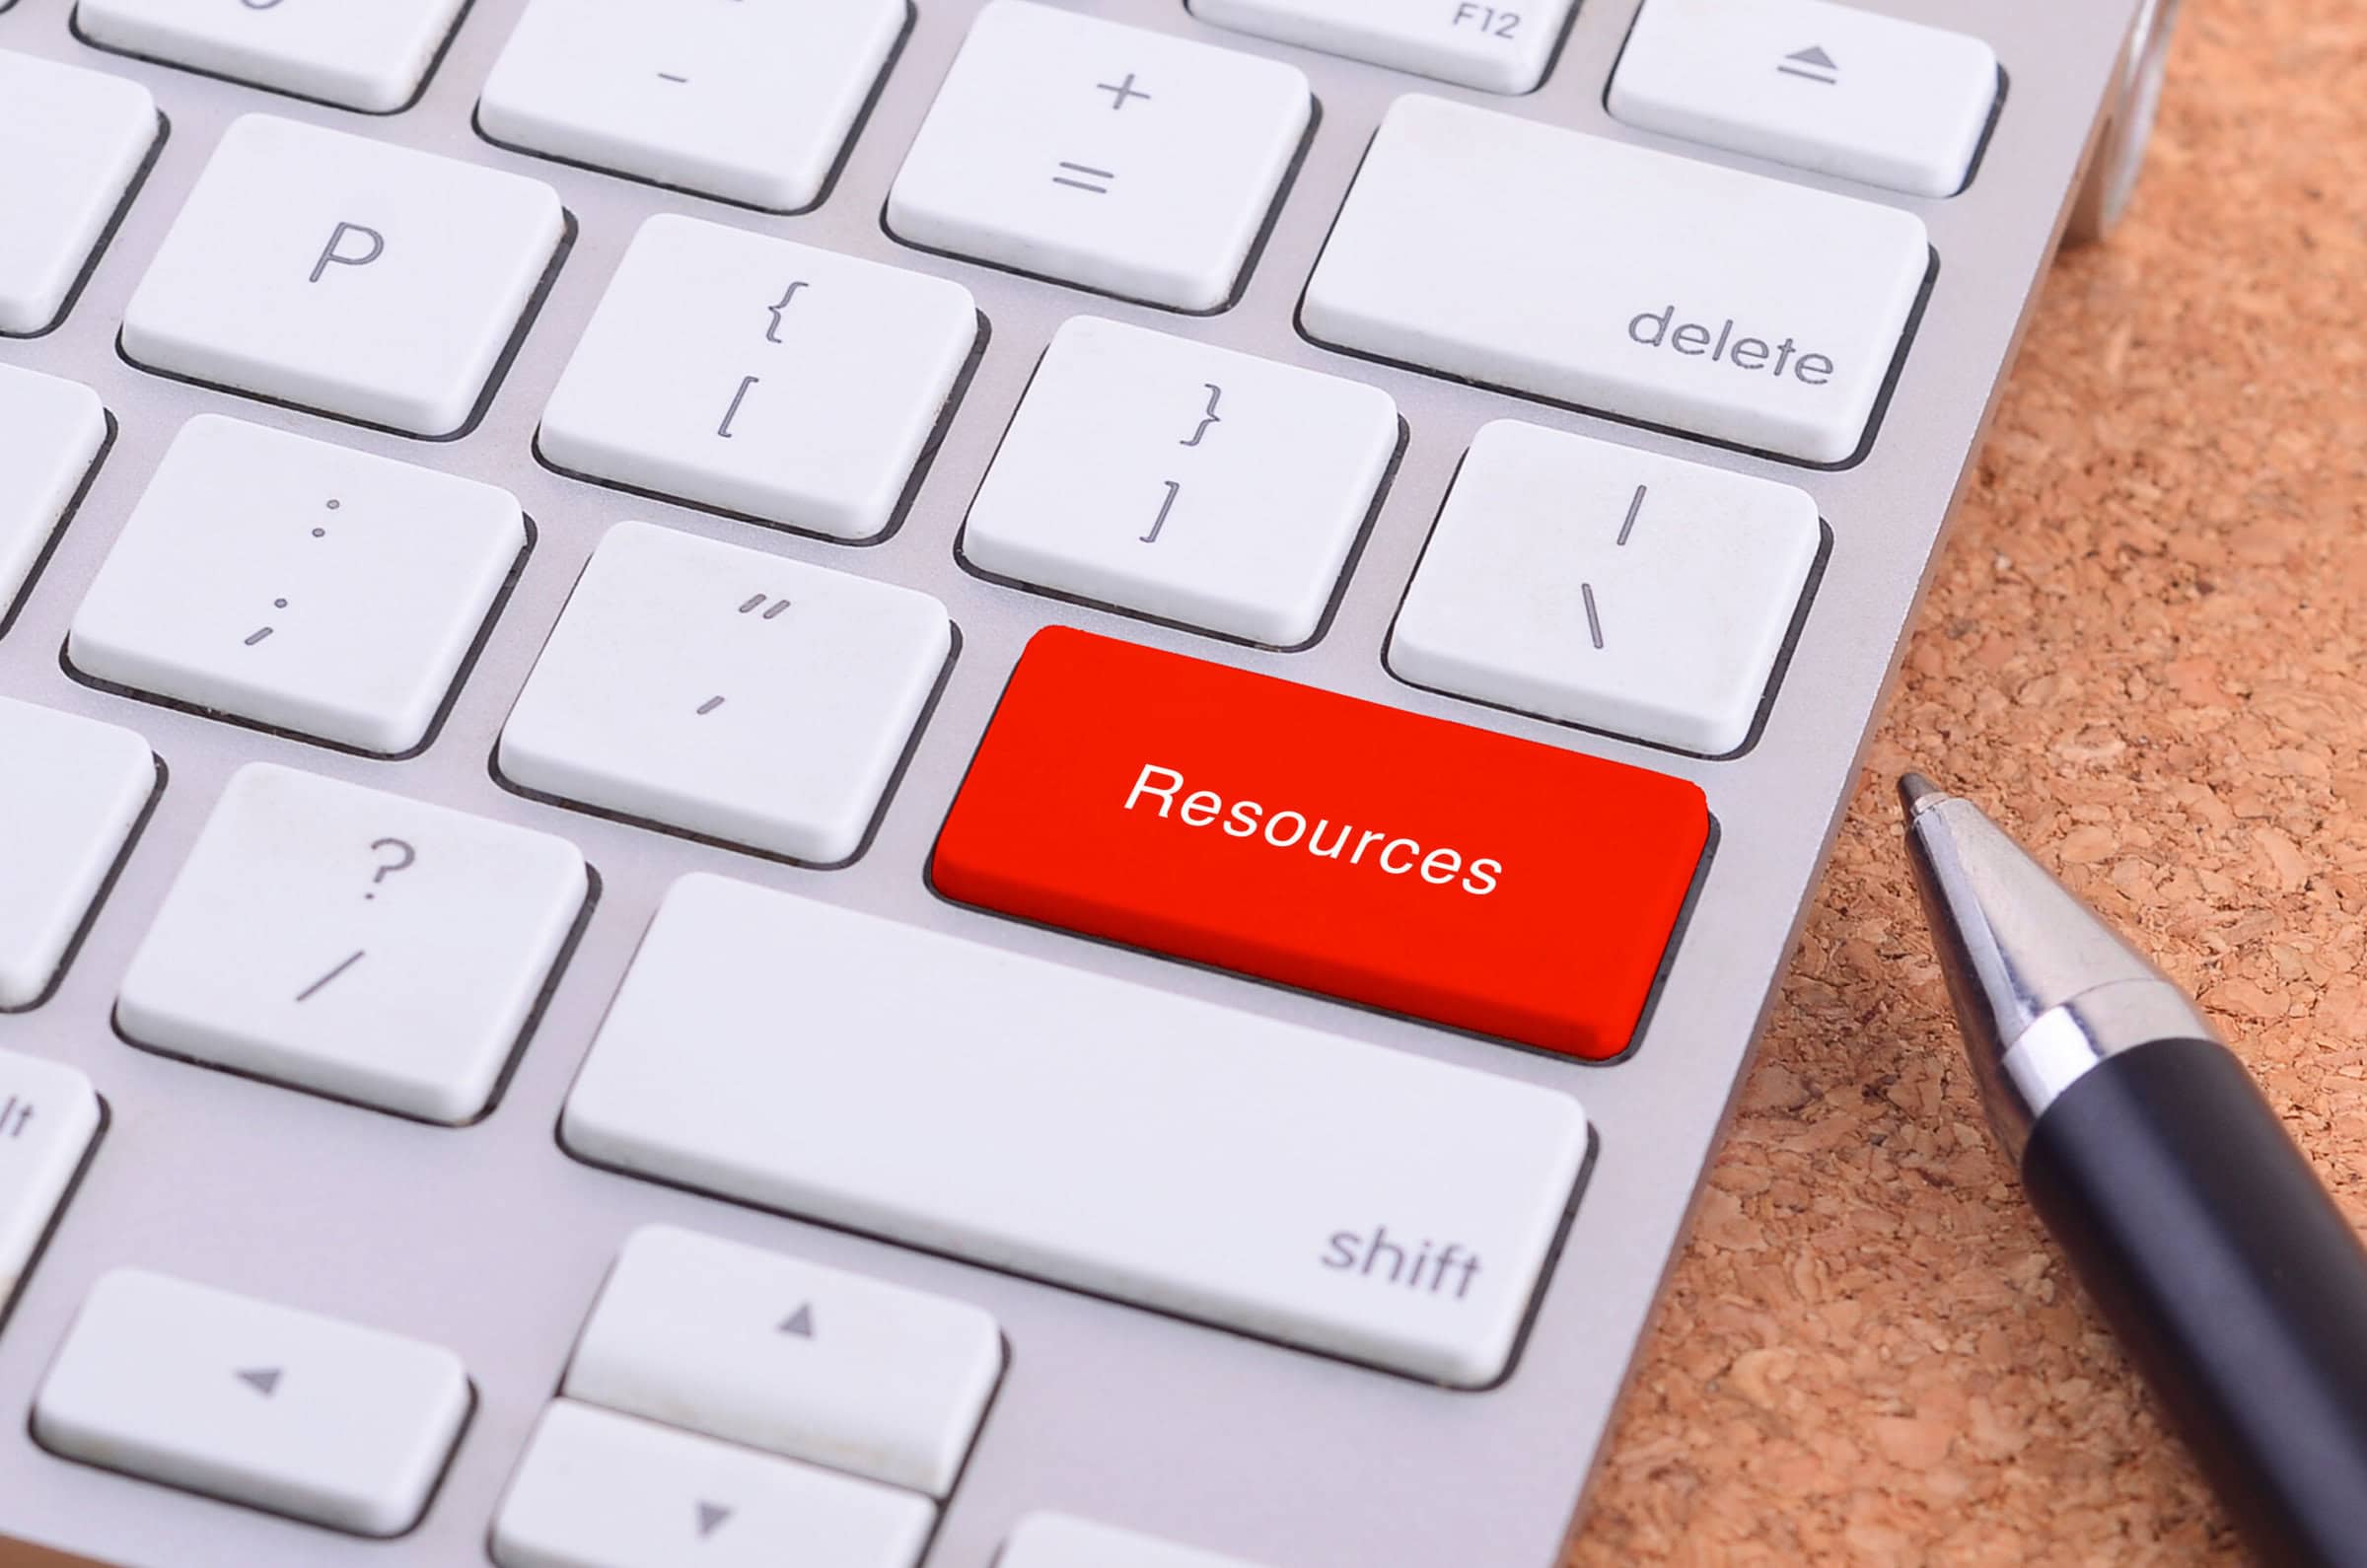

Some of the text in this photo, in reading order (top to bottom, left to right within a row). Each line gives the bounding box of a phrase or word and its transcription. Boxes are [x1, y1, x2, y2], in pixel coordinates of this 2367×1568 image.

[1453, 2, 1521, 39] F12
[1096, 73, 1152, 110] +
[1051, 161, 1116, 194] =
[308, 221, 385, 284] P
[765, 280, 811, 344] {
[1627, 305, 1835, 386] delete
[716, 375, 760, 440] [
[1178, 383, 1223, 448] }
[311, 499, 340, 538] :
[1138, 479, 1181, 544] ]
[244, 598, 289, 647] ;
[1580, 582, 1605, 651] \
[1124, 763, 1503, 896] Resources
[364, 836, 416, 901] ?
[295, 950, 366, 1003] /
[1322, 1226, 1480, 1301] shift
